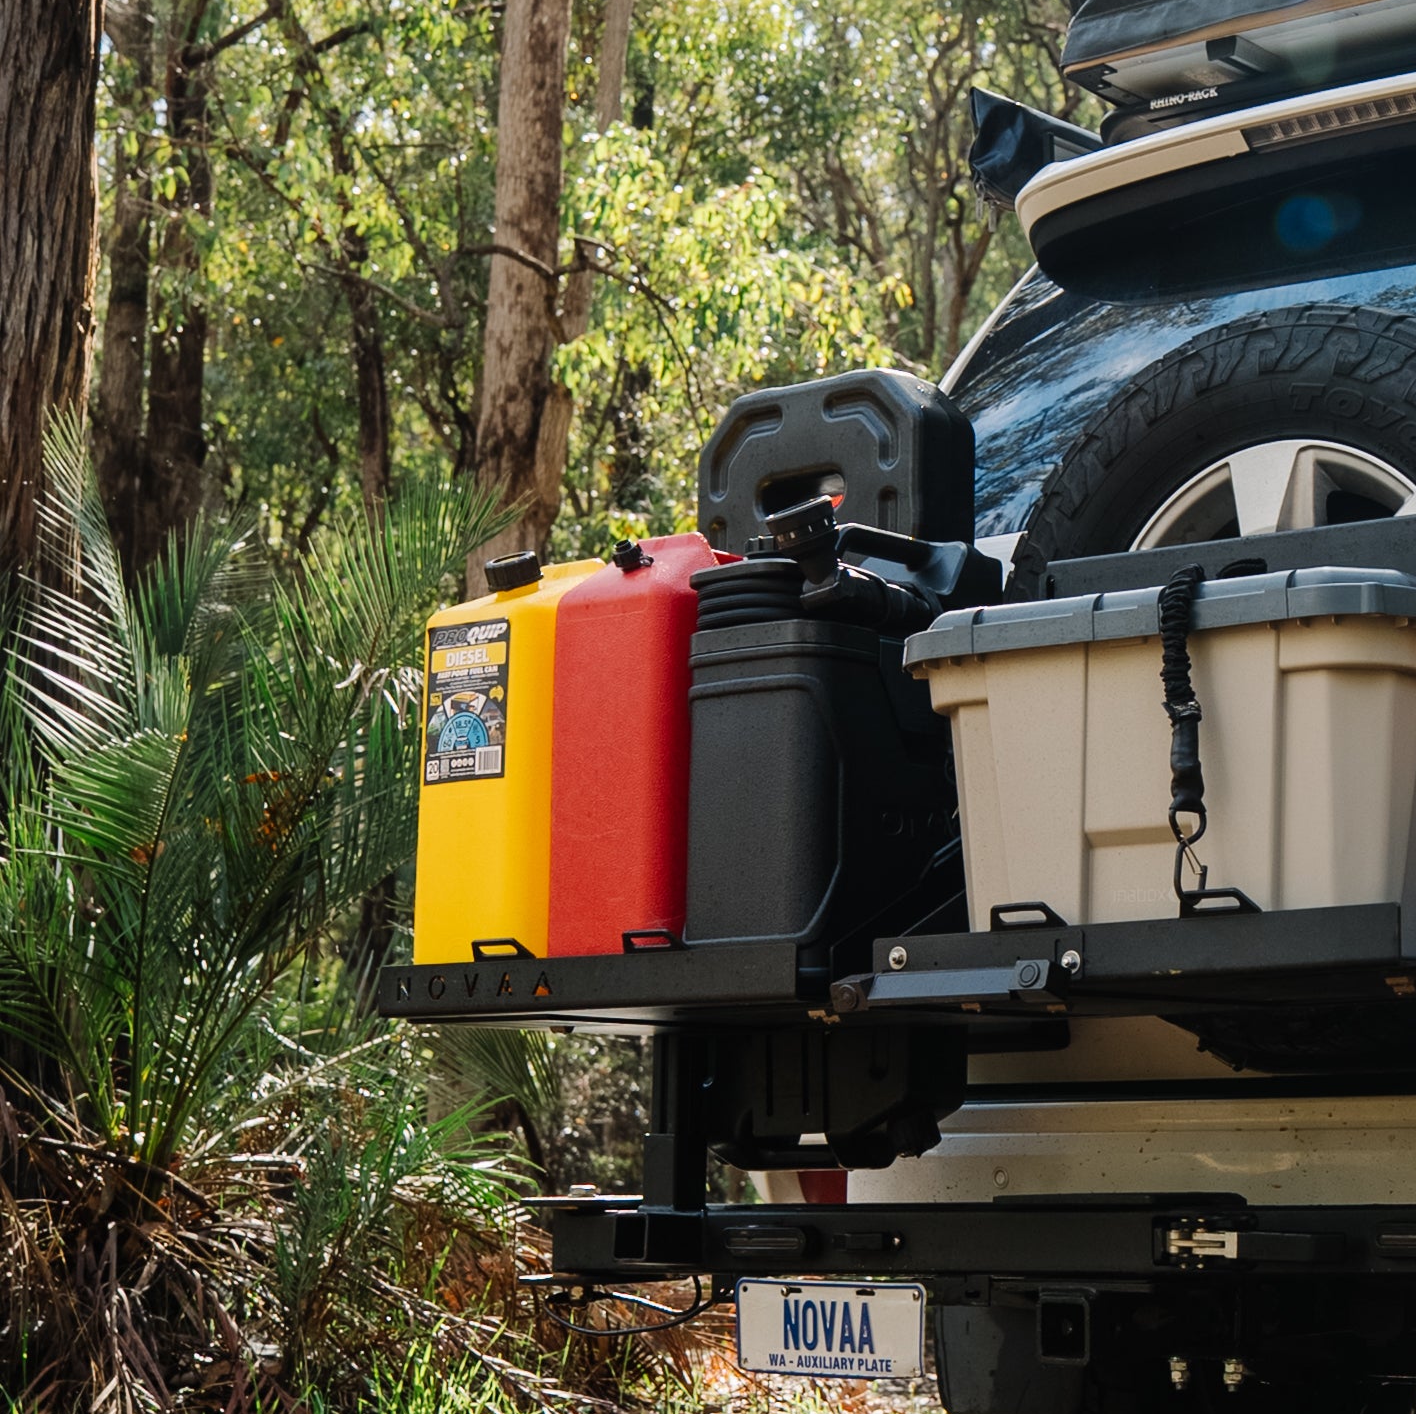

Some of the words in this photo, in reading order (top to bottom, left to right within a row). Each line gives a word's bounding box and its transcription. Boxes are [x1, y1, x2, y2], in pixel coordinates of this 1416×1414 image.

[1149, 86, 1218, 110] RHINO-RACK
[432, 622, 508, 647] PROQUIP
[445, 647, 490, 667] DIESEL
[428, 763, 439, 774] 20
[396, 971, 553, 1001] NOVAA
[783, 1299, 875, 1354] NOVAA
[769, 1353, 786, 1367] WA
[797, 1355, 854, 1371] AUXILIARY
[858, 1358, 892, 1373] PLATE
